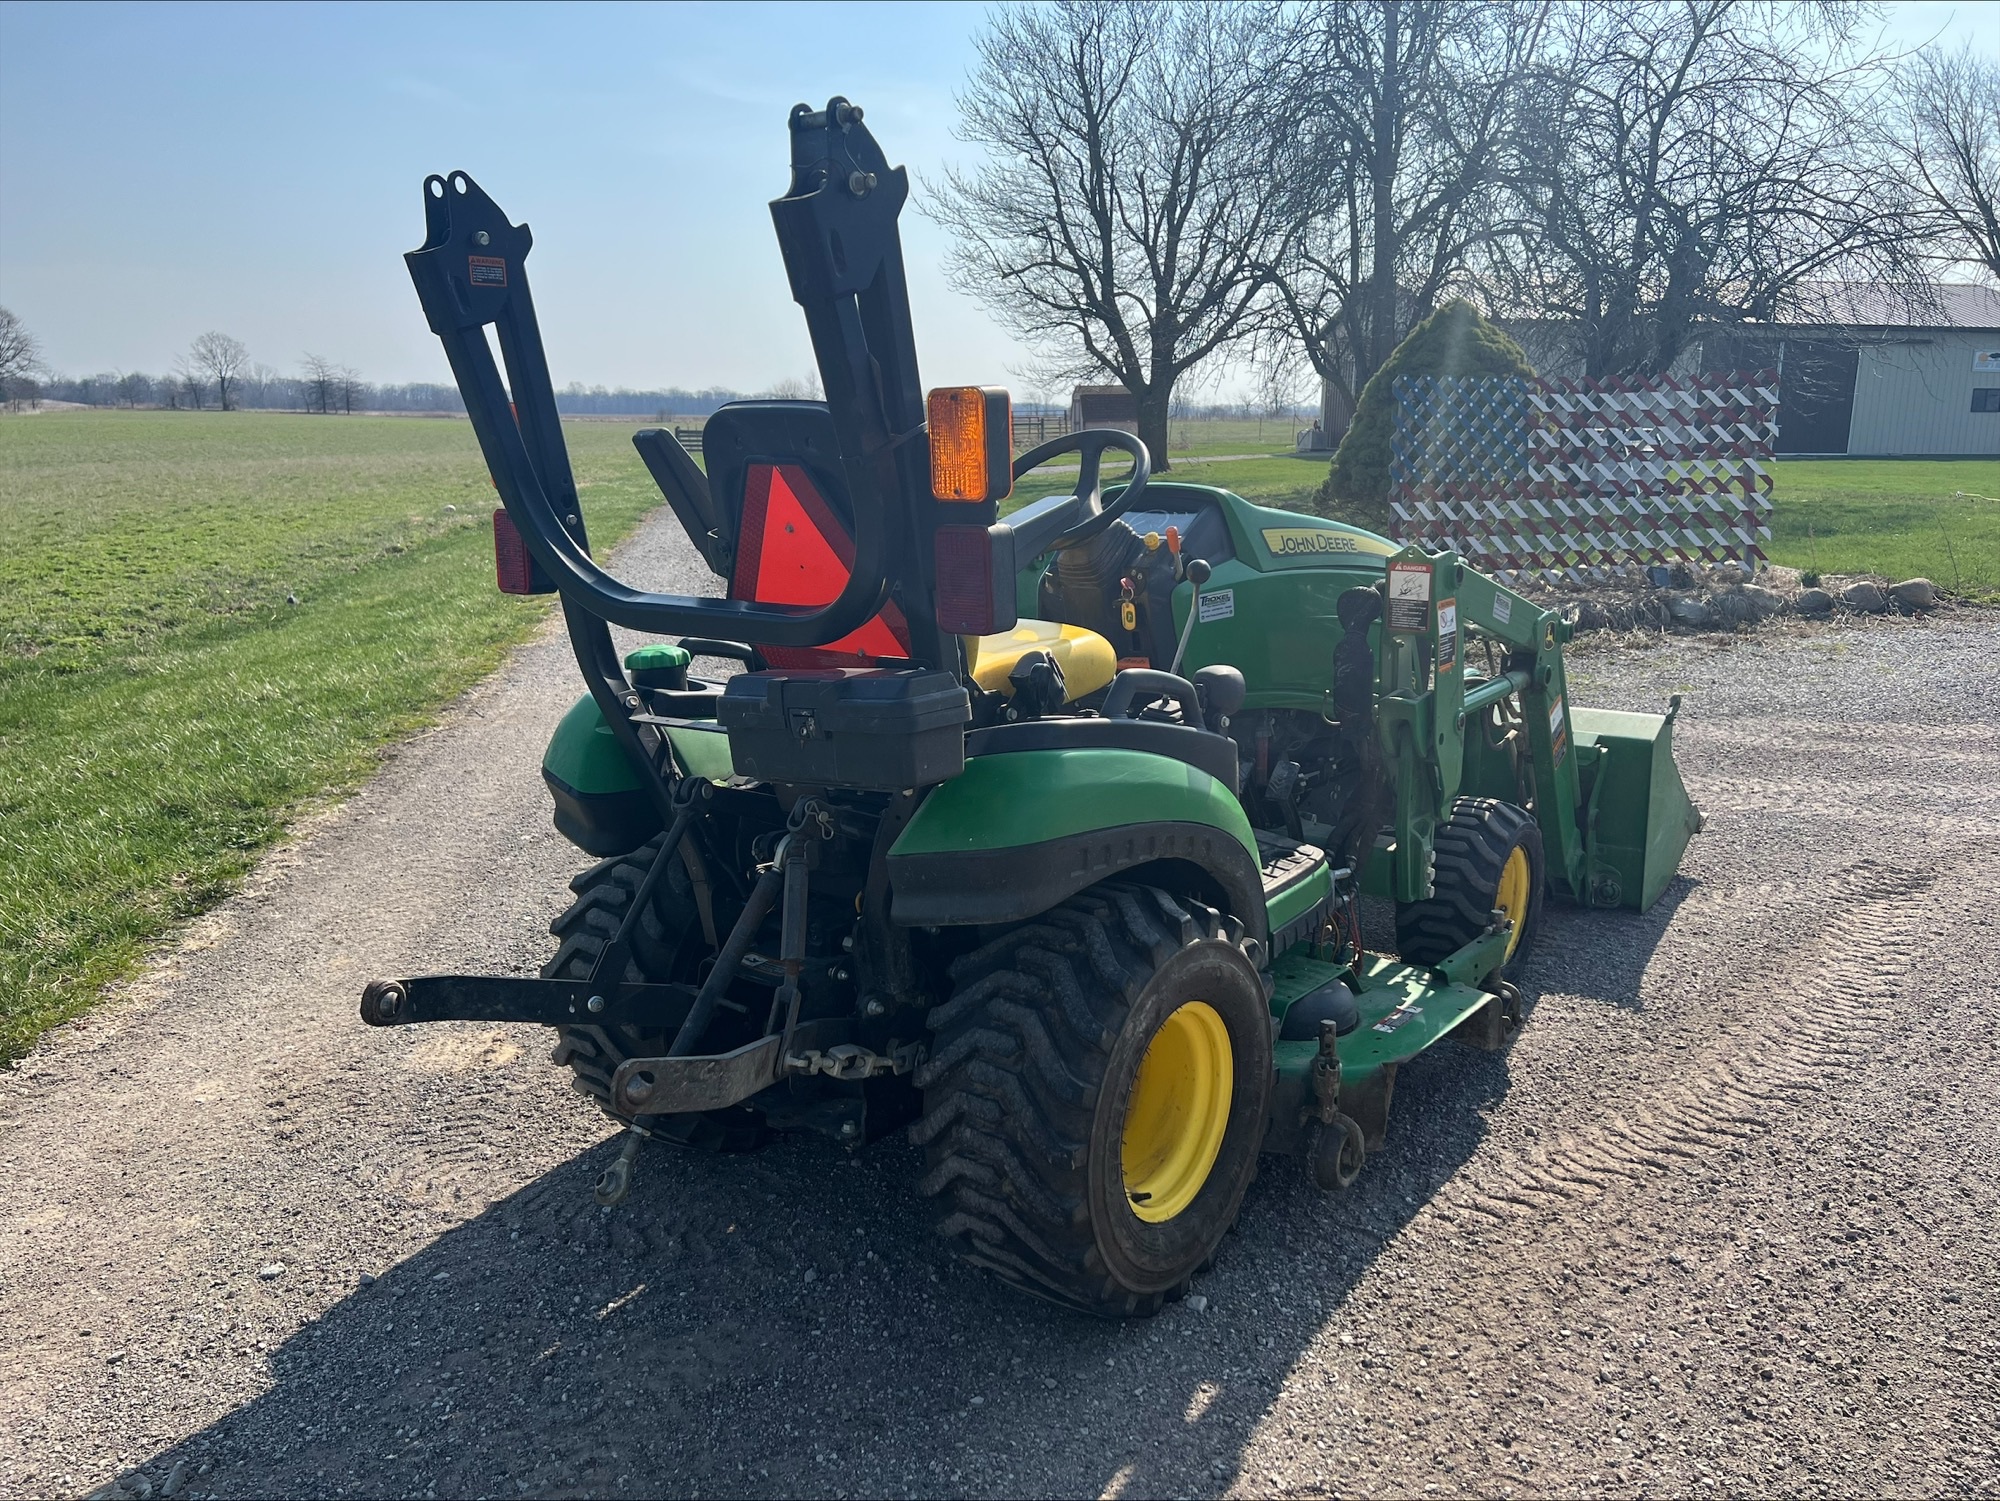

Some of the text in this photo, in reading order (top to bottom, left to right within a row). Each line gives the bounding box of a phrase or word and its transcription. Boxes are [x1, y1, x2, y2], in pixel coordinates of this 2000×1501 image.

[475, 257, 504, 265] WARNING
[1279, 534, 1357, 552] JOHN DEERE
[1200, 593, 1231, 606] TROXEL
